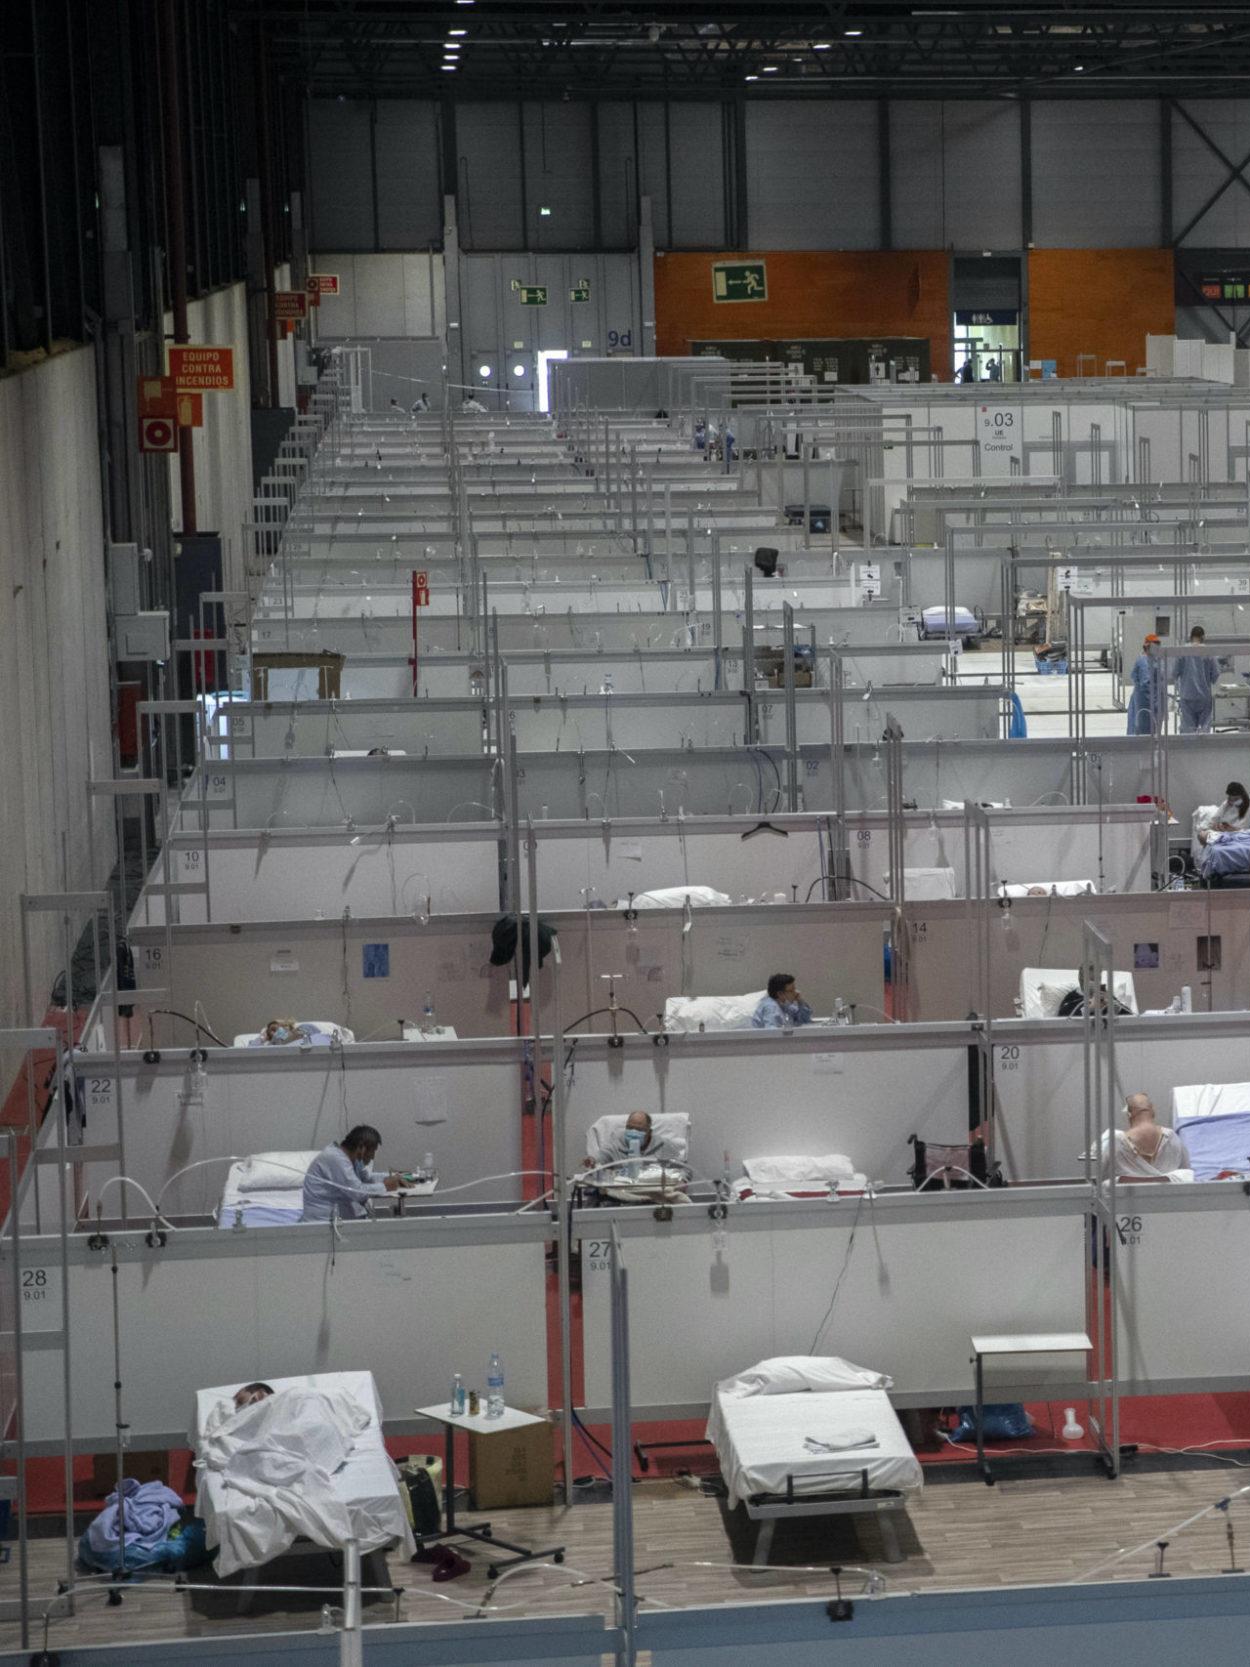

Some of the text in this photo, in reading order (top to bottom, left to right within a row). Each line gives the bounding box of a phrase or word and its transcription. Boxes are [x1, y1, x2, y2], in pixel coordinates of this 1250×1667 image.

[608, 330, 631, 347] 9d
[182, 351, 220, 361] EQUIPO
[181, 364, 222, 373] CONTRA
[175, 376, 230, 386] INCENDIOS
[984, 412, 1014, 427] 9.03
[984, 443, 1014, 452] Control
[213, 776, 226, 787] 04
[857, 830, 871, 841] 08
[185, 851, 200, 862] 10
[912, 922, 927, 933] 14
[145, 948, 161, 960] 16
[1001, 1045, 1020, 1060] 20
[1002, 1062, 1019, 1070] 9.01
[91, 1079, 111, 1093] 22
[92, 1096, 111, 1105] 9.01
[1120, 1216, 1142, 1232] 26
[1122, 1235, 1141, 1245] .01
[589, 1241, 611, 1258] 27
[590, 1261, 611, 1271] 9.01
[22, 1268, 47, 1287] 28
[23, 1290, 46, 1301] 9.01
